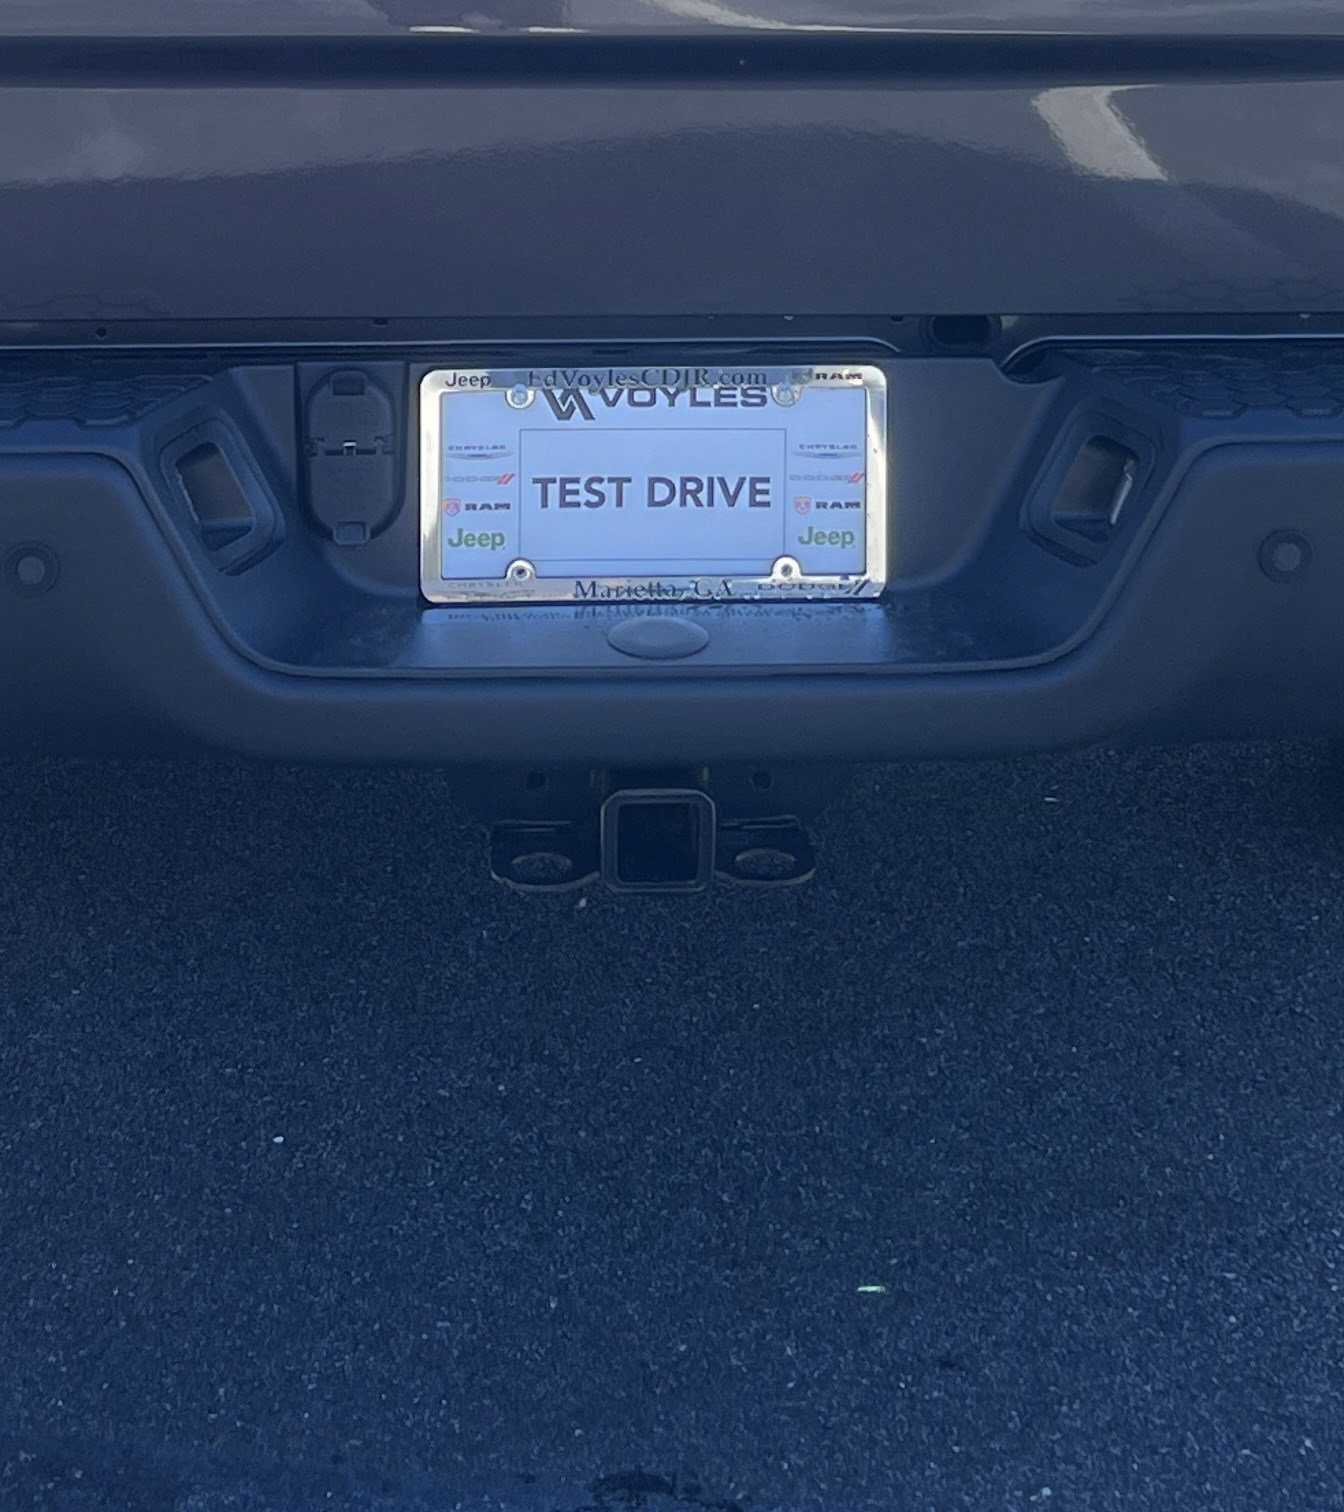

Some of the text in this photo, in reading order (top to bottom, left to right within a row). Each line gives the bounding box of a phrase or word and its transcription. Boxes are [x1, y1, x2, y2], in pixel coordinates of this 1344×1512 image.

[445, 372, 492, 388] Jeep
[599, 386, 768, 408] VOYLES
[532, 476, 772, 509] TEST DRIVE
[464, 502, 512, 511] RAM
[815, 501, 861, 509] RAM
[447, 527, 506, 551] Jeep
[797, 526, 856, 549] Jeep
